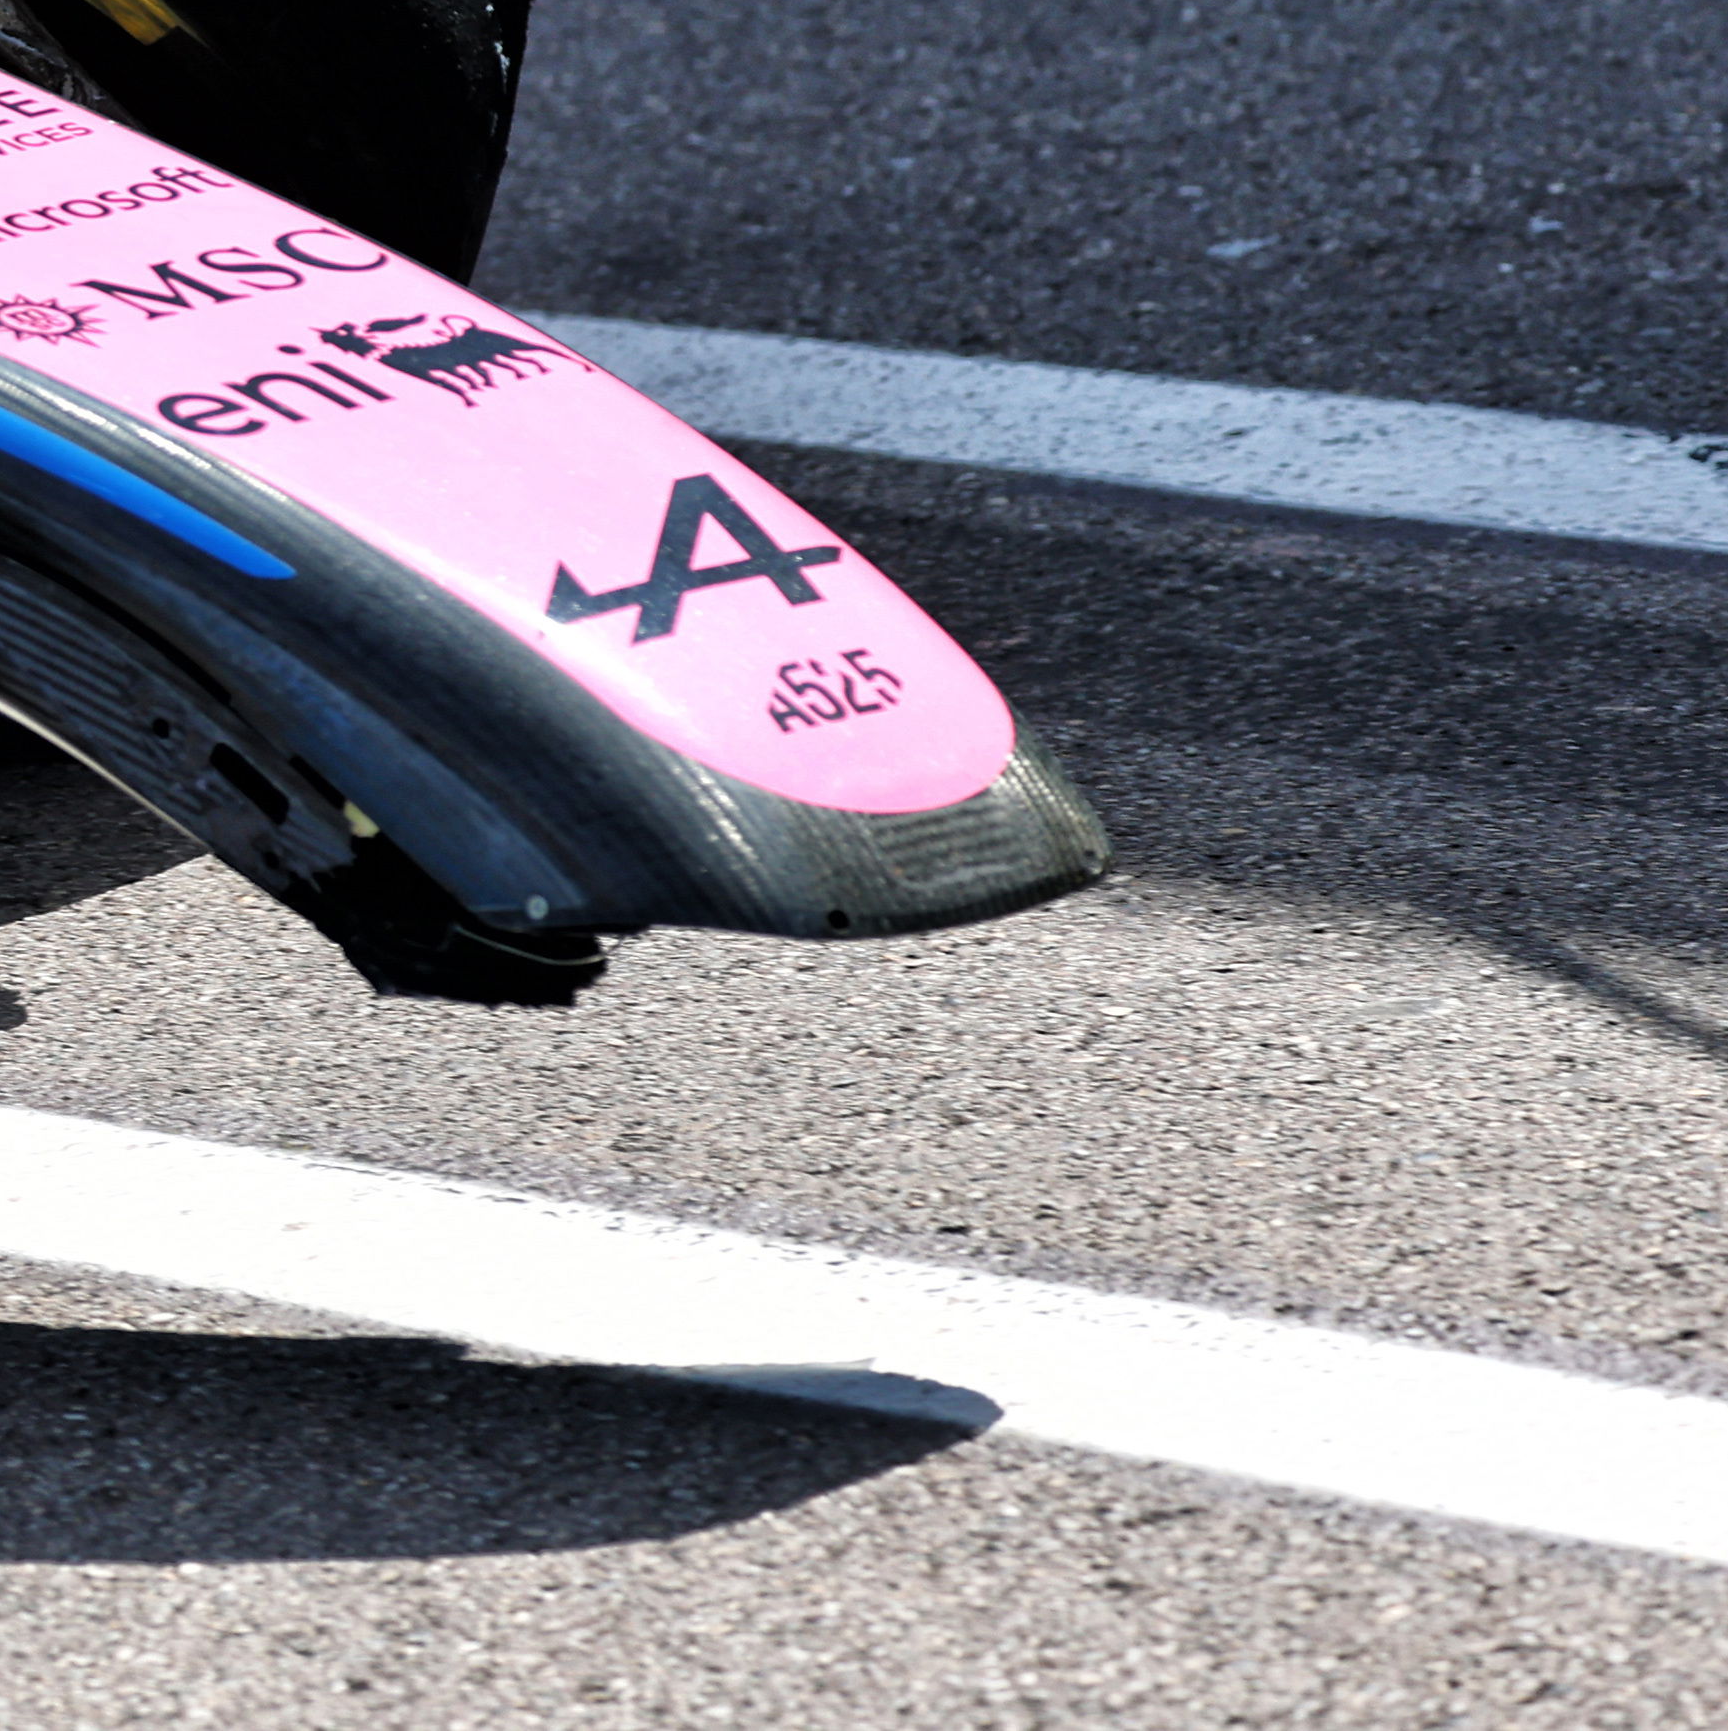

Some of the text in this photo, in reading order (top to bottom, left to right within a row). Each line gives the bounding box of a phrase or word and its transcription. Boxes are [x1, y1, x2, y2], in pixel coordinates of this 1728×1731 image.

[68, 226, 390, 321] MSC
[156, 343, 395, 438] eni
[767, 648, 904, 734] A525
